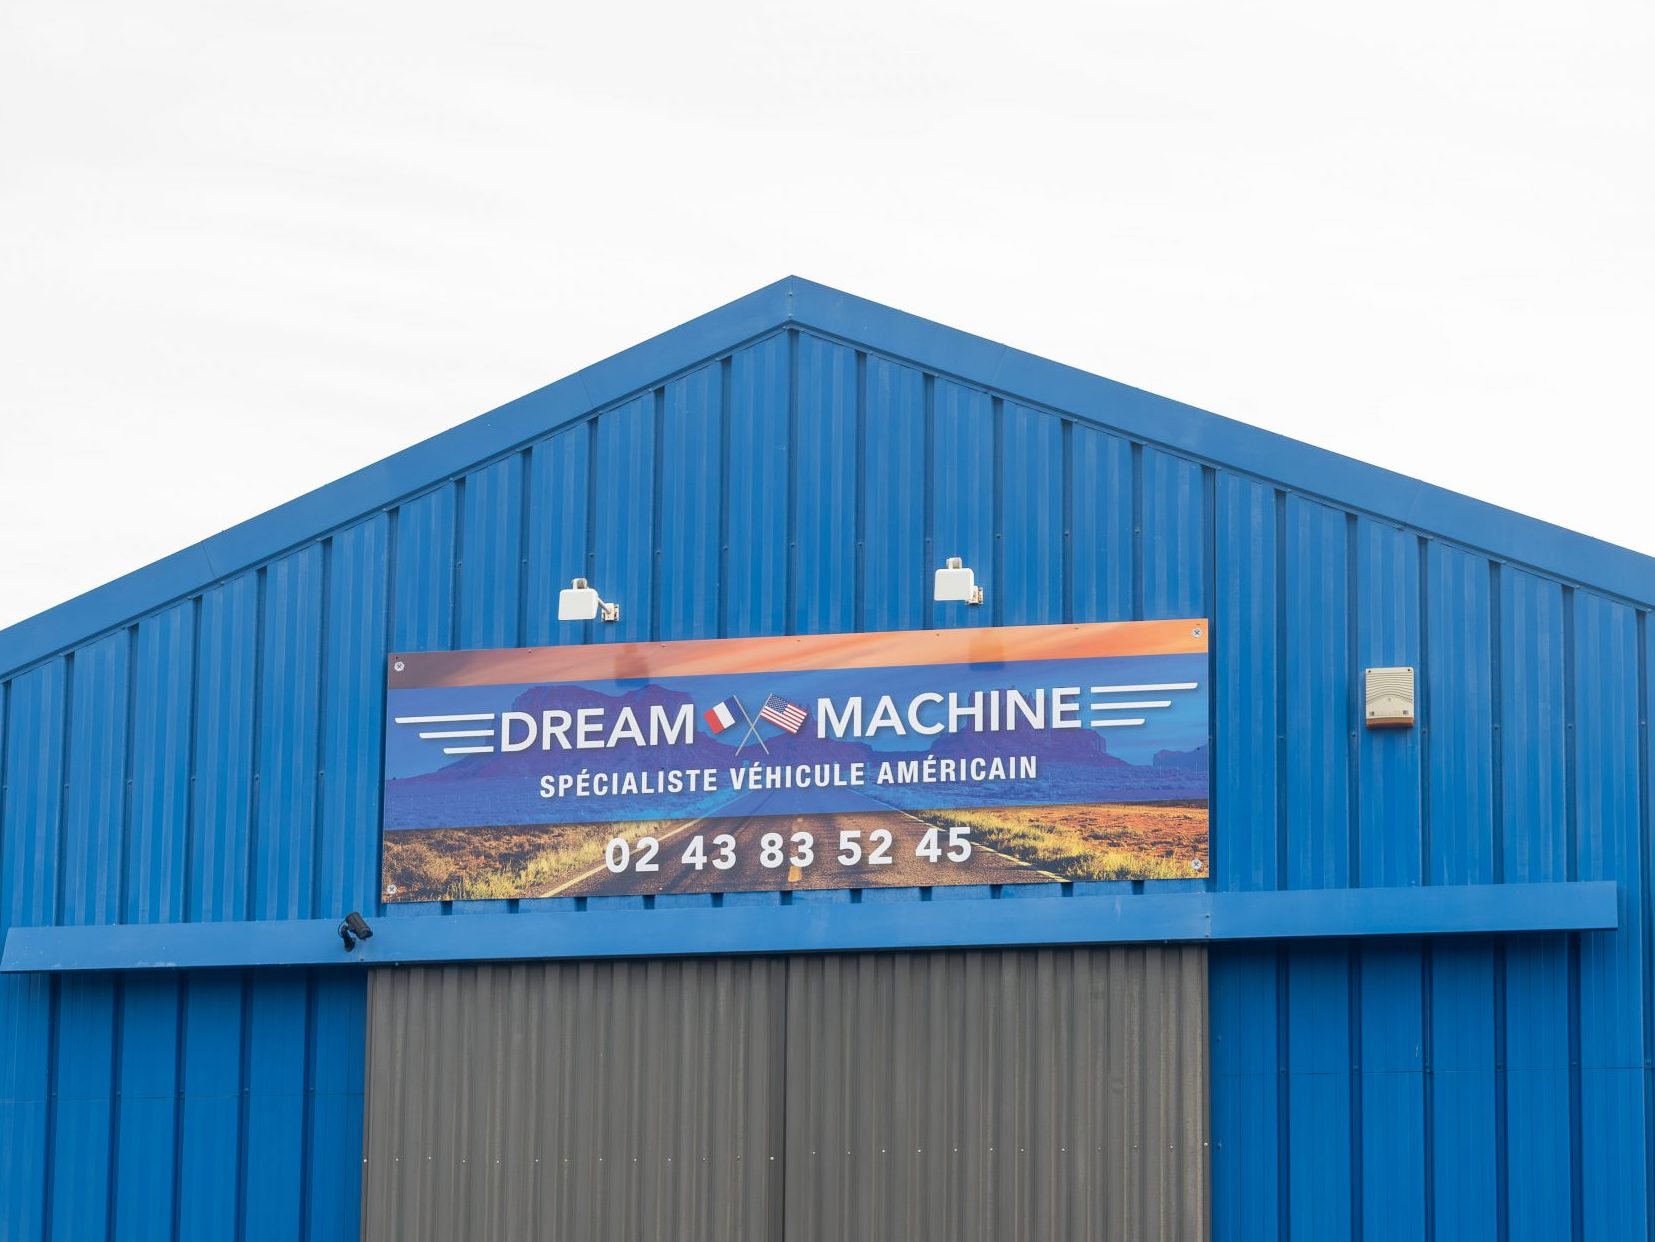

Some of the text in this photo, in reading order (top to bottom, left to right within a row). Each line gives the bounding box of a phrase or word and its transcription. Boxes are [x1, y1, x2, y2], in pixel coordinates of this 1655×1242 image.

[500, 686, 1082, 753] DREAM MACHINE
[539, 755, 1037, 798] SPÉCIALISTE VÉHICULE AMÉRICAIN
[604, 826, 972, 873] 02 43 83 52 45
